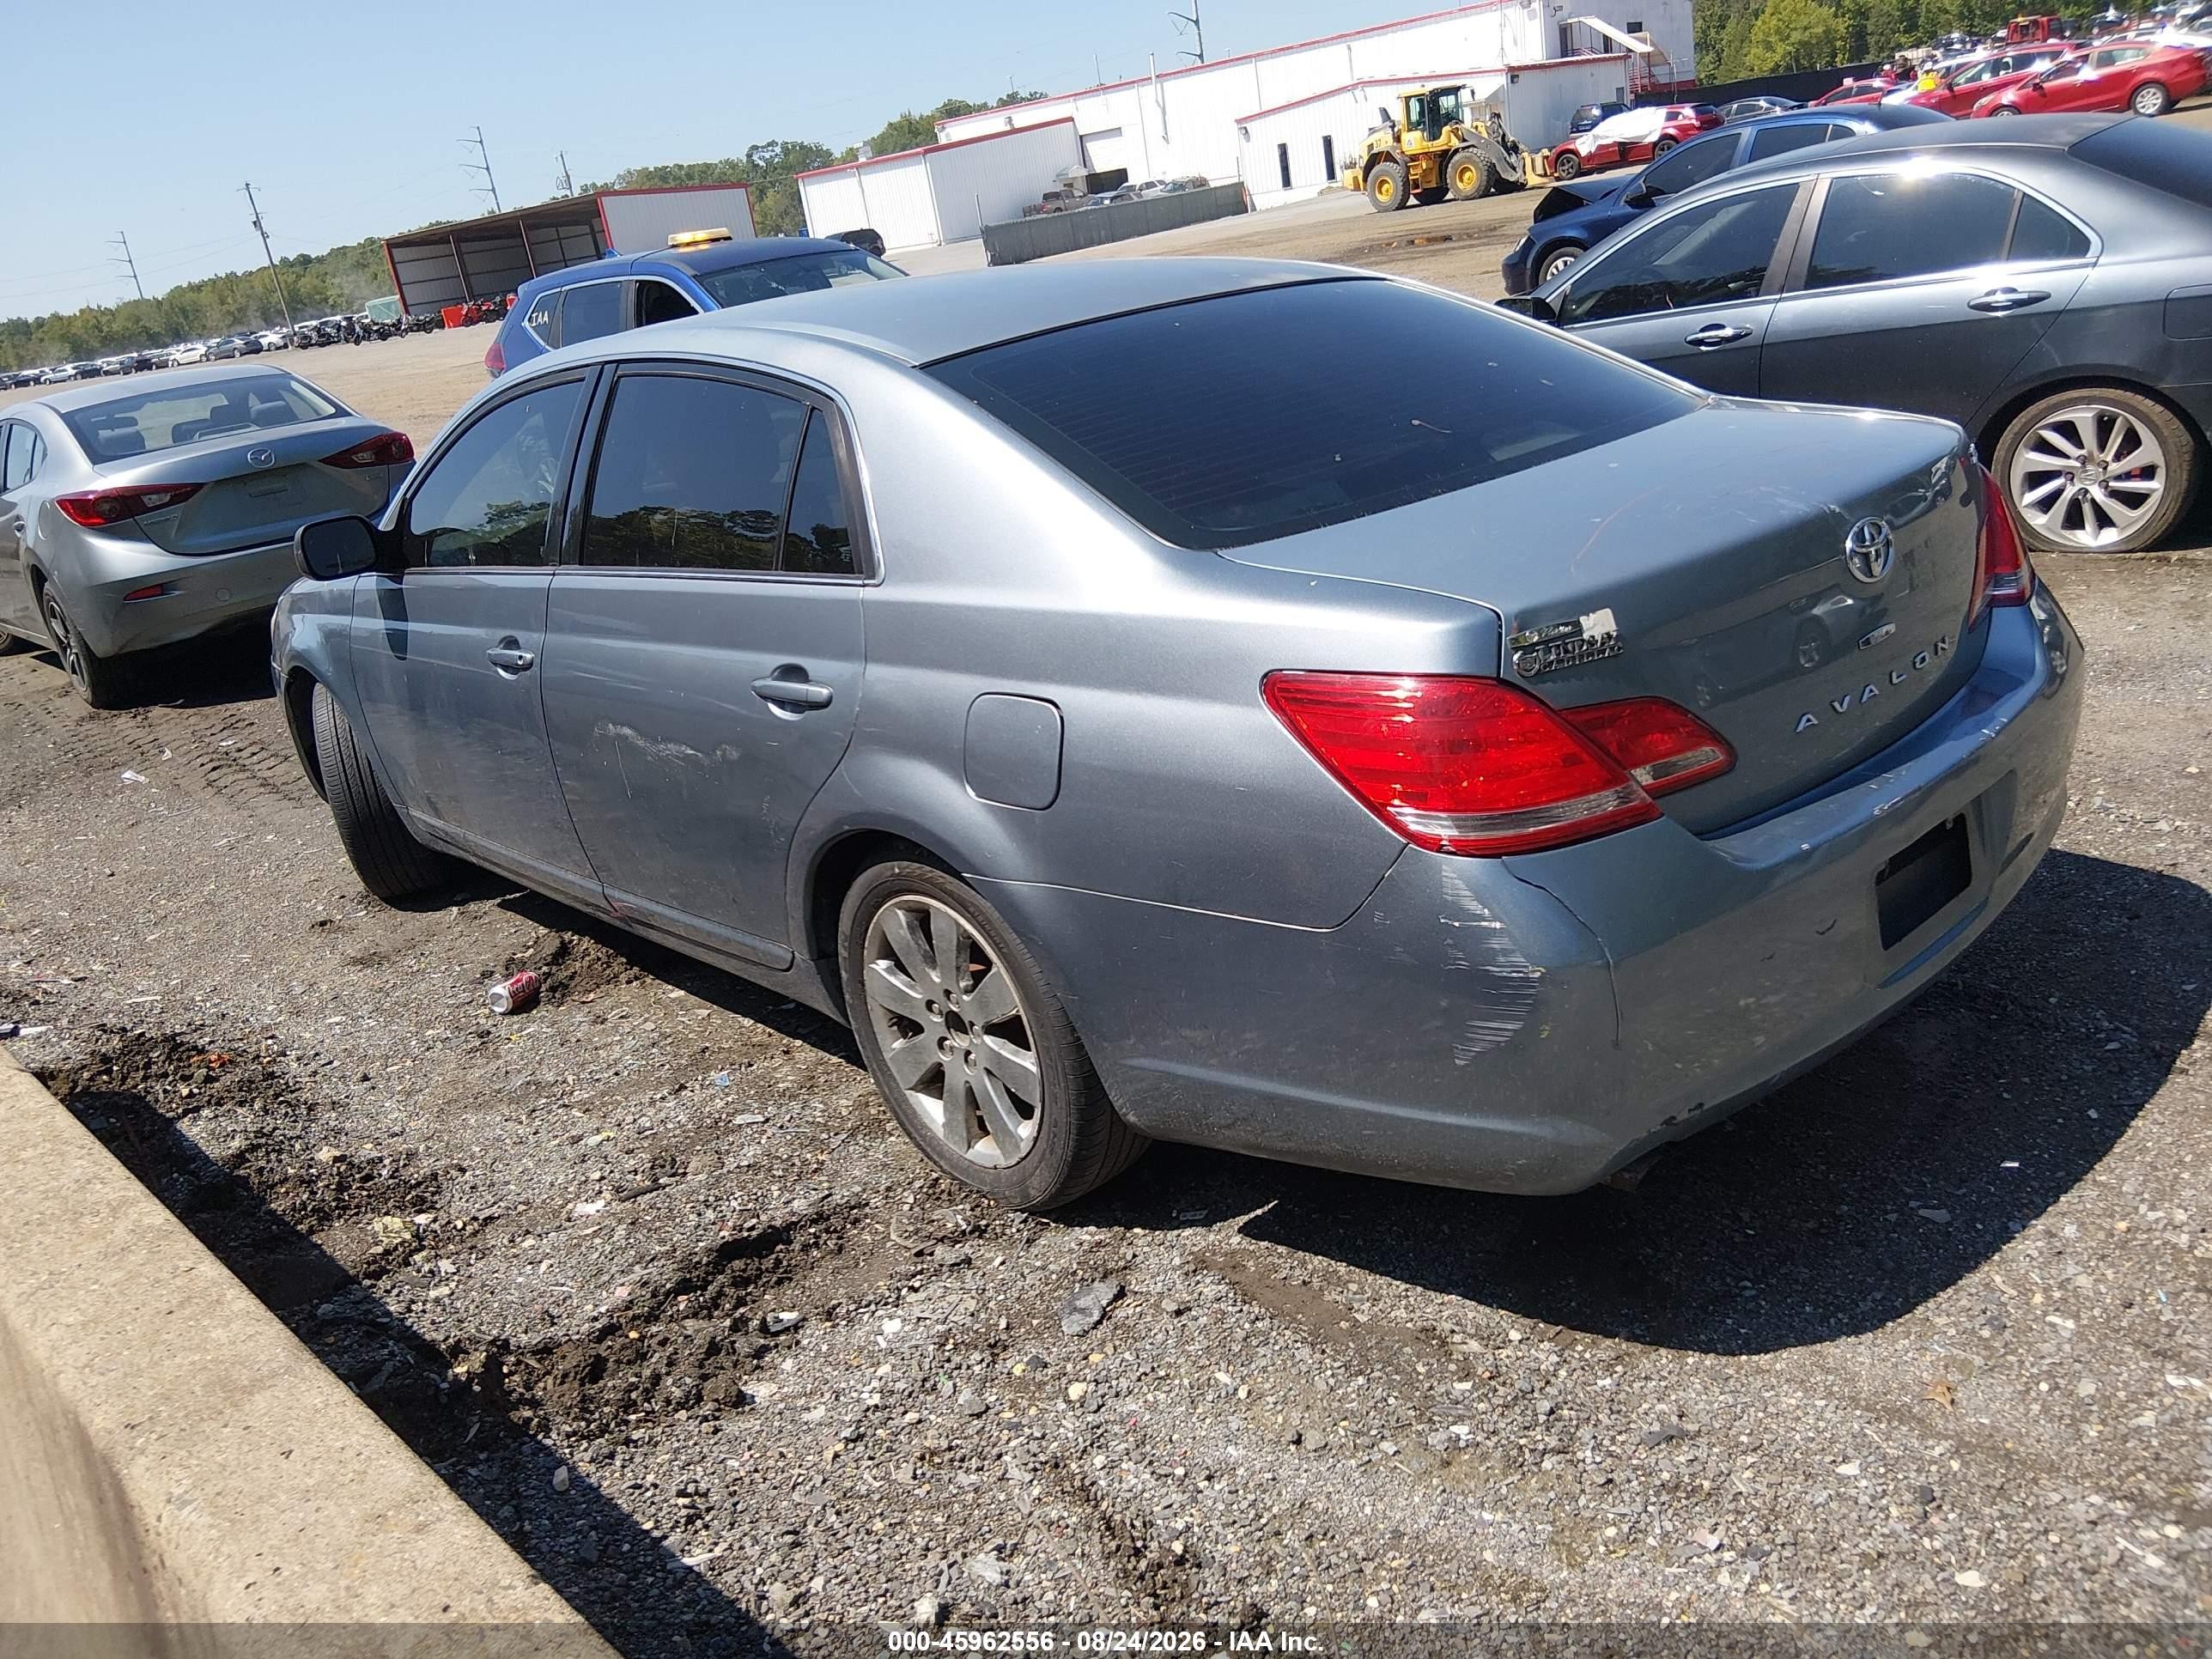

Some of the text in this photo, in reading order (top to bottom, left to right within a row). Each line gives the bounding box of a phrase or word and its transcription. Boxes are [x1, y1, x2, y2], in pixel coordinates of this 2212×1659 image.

[531, 310, 550, 327] IAA
[1540, 645, 1624, 673] CADILLAC
[1795, 635, 1950, 733] AVALON
